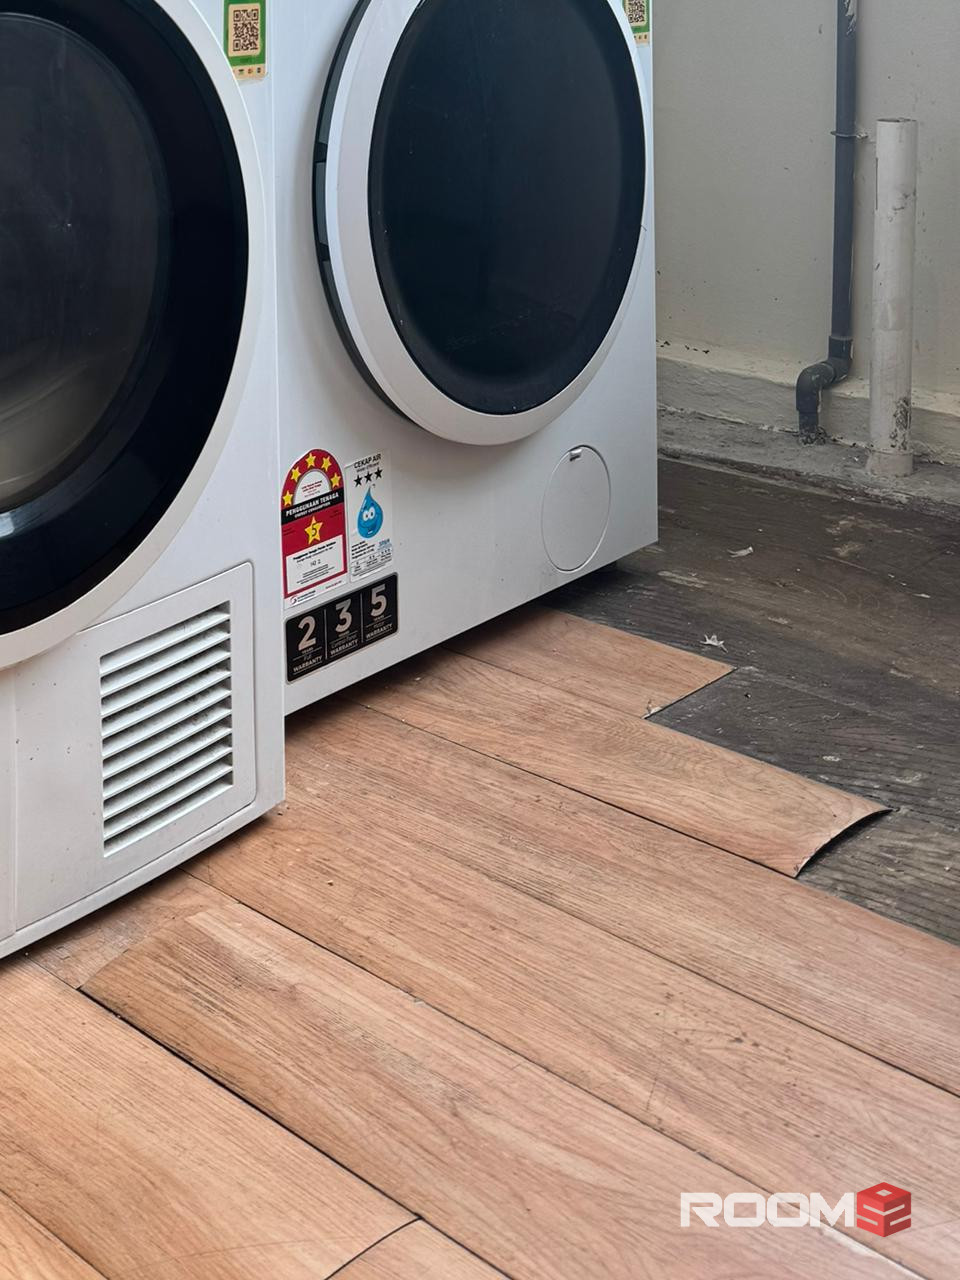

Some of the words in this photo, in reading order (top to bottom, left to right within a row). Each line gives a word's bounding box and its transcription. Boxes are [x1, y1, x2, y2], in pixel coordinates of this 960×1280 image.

[353, 456, 372, 469] CEKAP
[372, 453, 382, 463] AIR
[285, 498, 320, 517] PENGGUNAAN
[320, 492, 339, 504] TENAGA
[311, 523, 318, 537] 5
[298, 615, 316, 651] 2
[335, 598, 353, 633] 3
[370, 583, 387, 617] 5
[292, 655, 323, 673] WARRANTY
[330, 639, 359, 655] WARRANTY
[366, 623, 393, 639] WARRANTY
